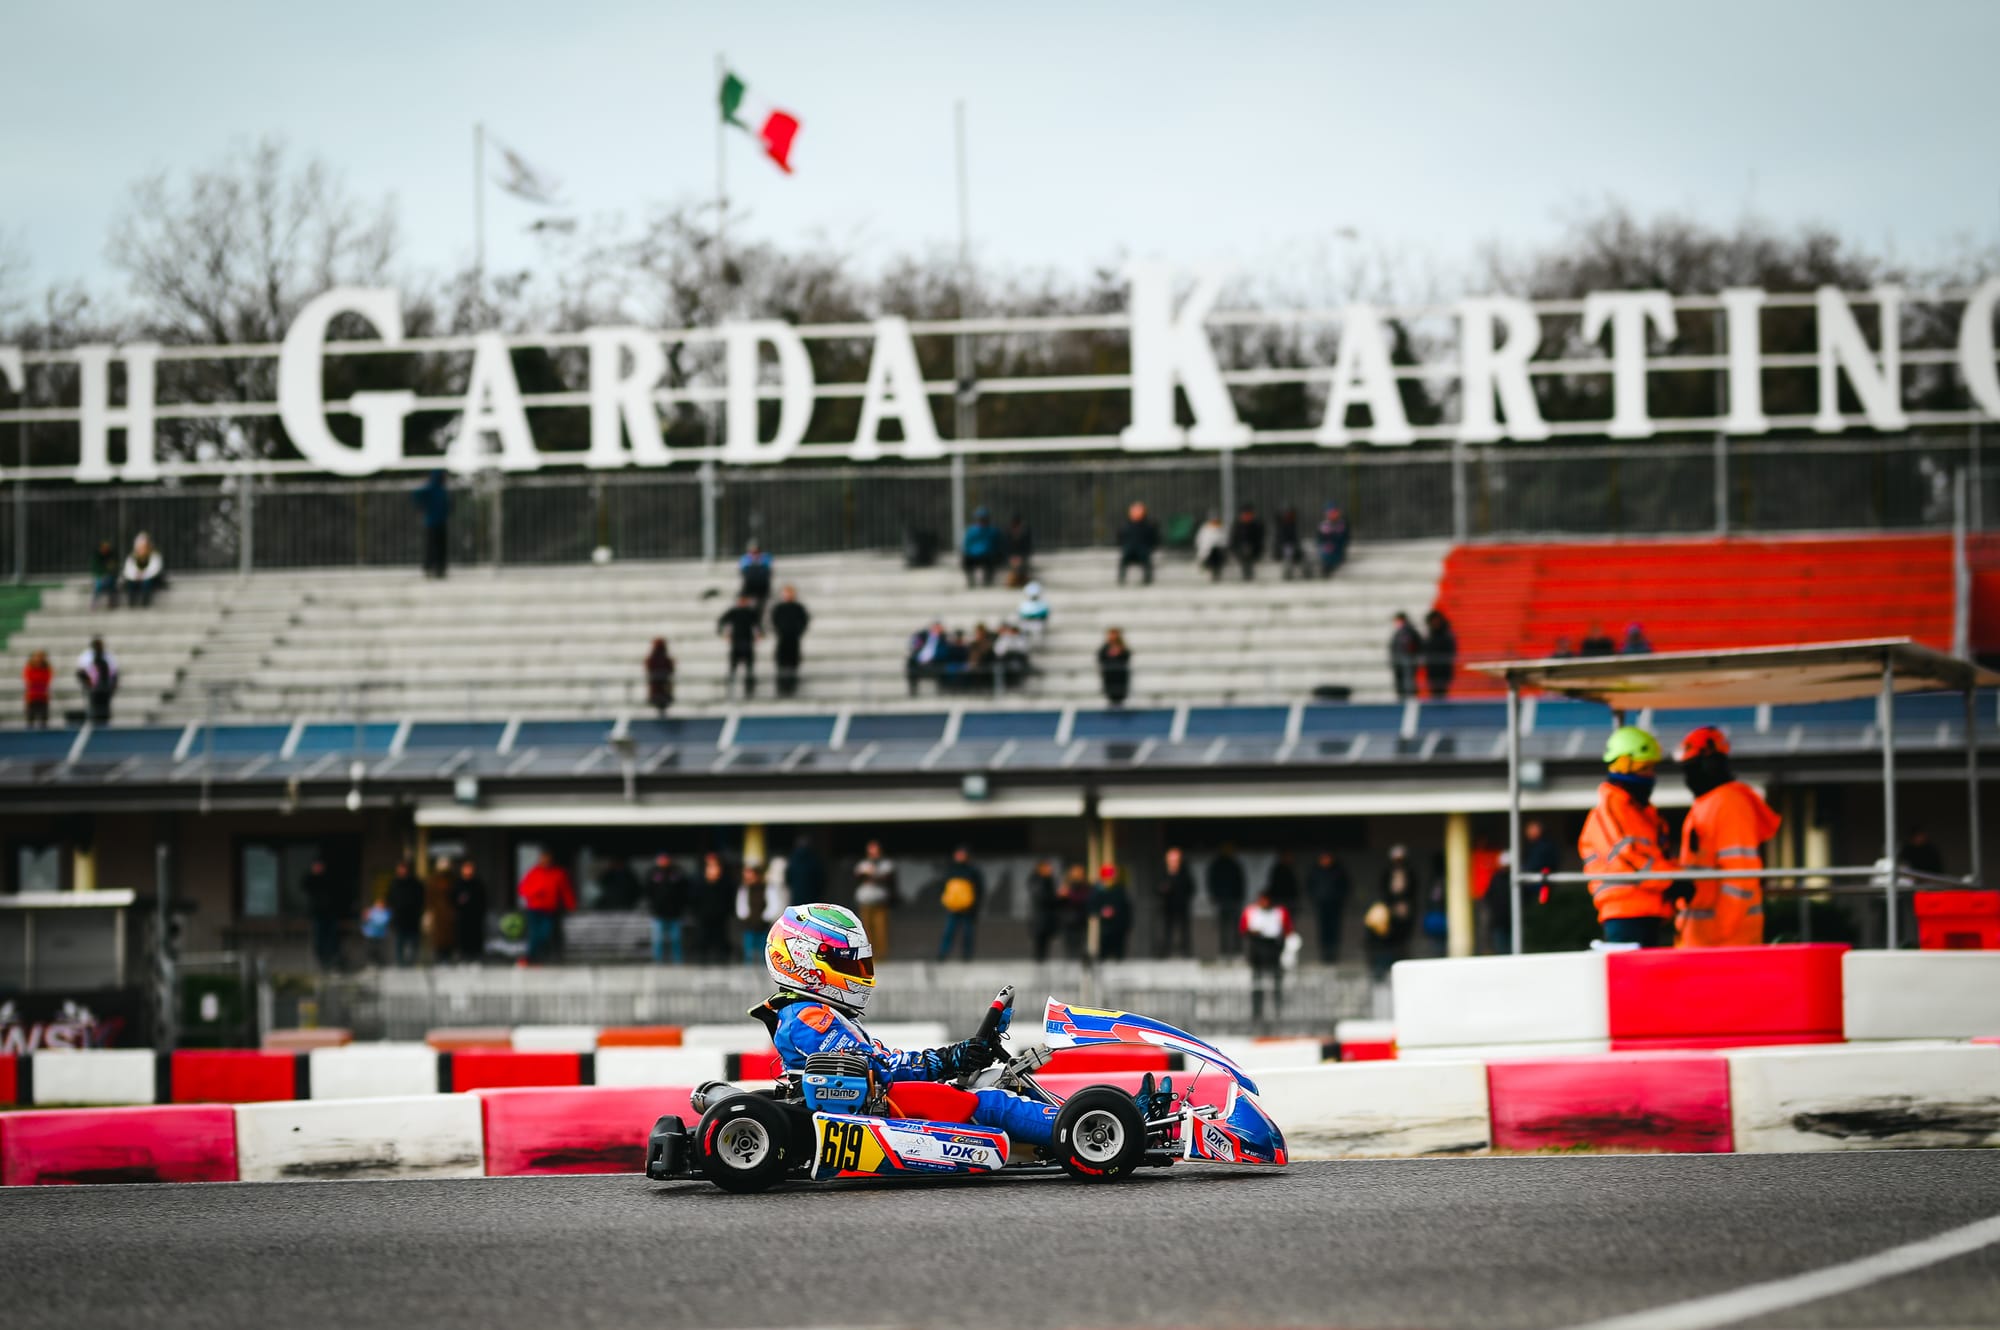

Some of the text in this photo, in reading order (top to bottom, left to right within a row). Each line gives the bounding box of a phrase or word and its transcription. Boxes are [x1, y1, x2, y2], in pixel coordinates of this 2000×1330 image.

[0, 343, 160, 482] H
[277, 286, 946, 477] GARDA
[821, 1121, 864, 1172] 619
[942, 1143, 974, 1160] VDK
[1206, 1128, 1223, 1147] VDK
